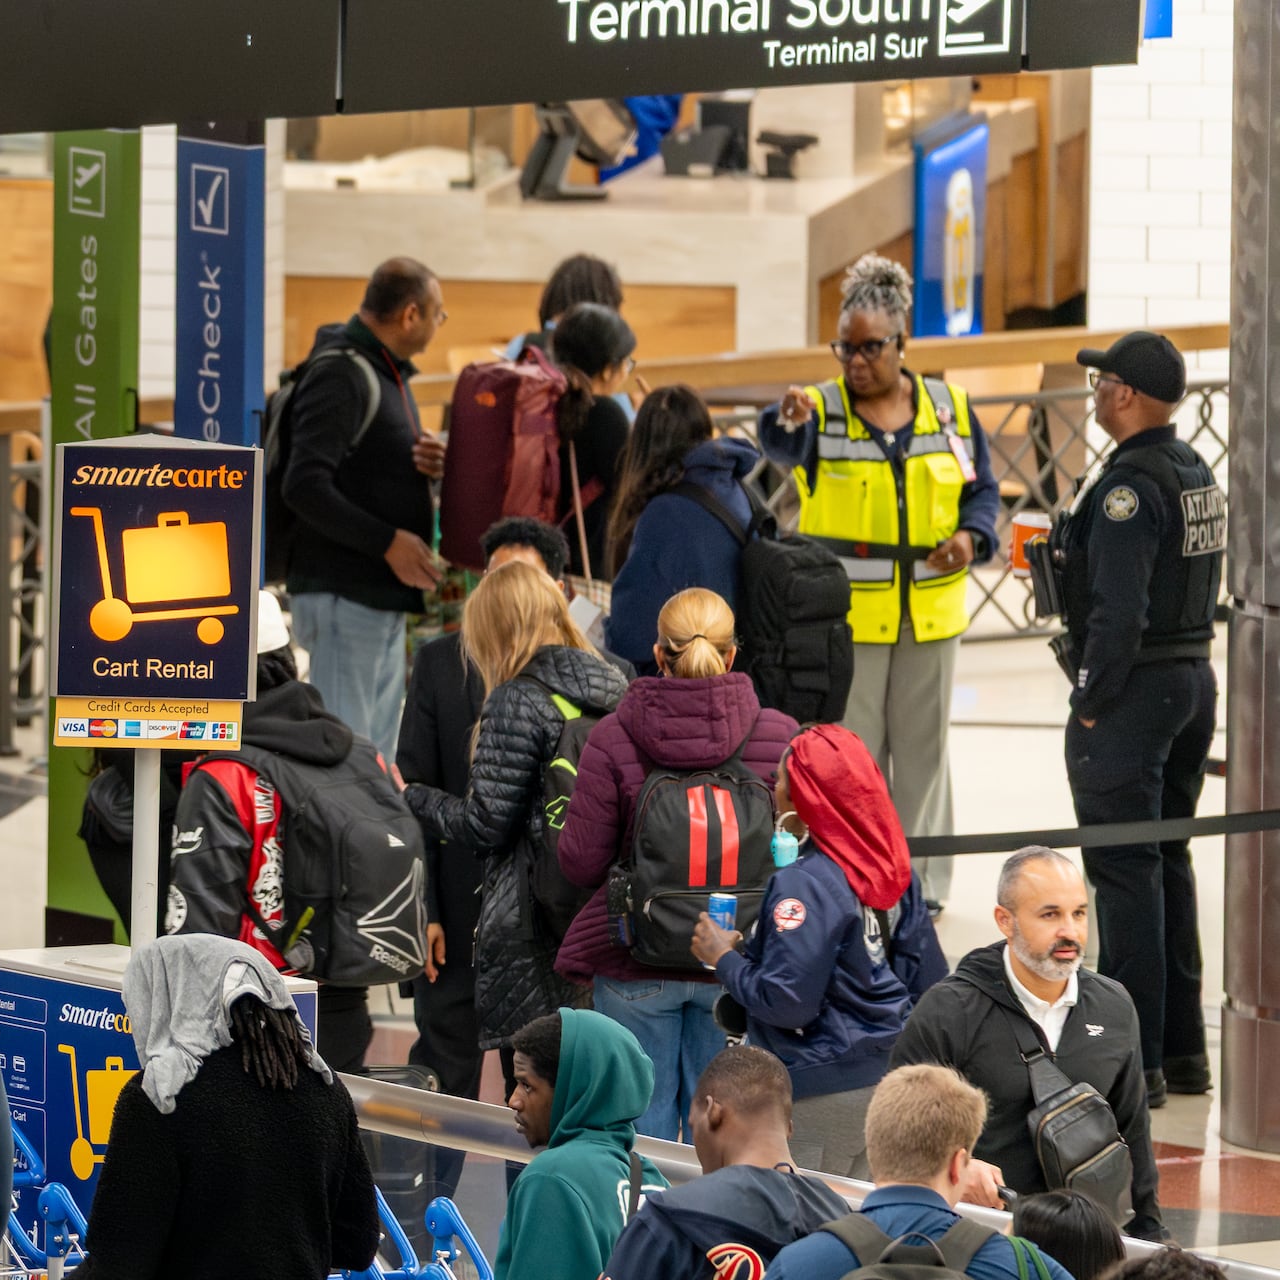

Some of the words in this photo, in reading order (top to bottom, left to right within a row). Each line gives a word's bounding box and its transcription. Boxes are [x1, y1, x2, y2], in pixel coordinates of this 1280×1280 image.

[559, 0, 771, 42] Terminal
[763, 34, 876, 68] Terminal
[884, 33, 929, 60] Sur
[74, 235, 98, 366] Gates
[74, 384, 97, 439] All
[71, 463, 244, 489] smartecarte
[92, 657, 139, 678] Cart
[146, 658, 214, 679] Rental
[87, 701, 120, 712] Credit
[124, 702, 156, 713] Cards
[160, 702, 209, 716] Accepted
[62, 723, 86, 732] VISA
[212, 723, 233, 738] JCB
[369, 944, 411, 975] Reebok
[13, 1110, 27, 1122] Cart
